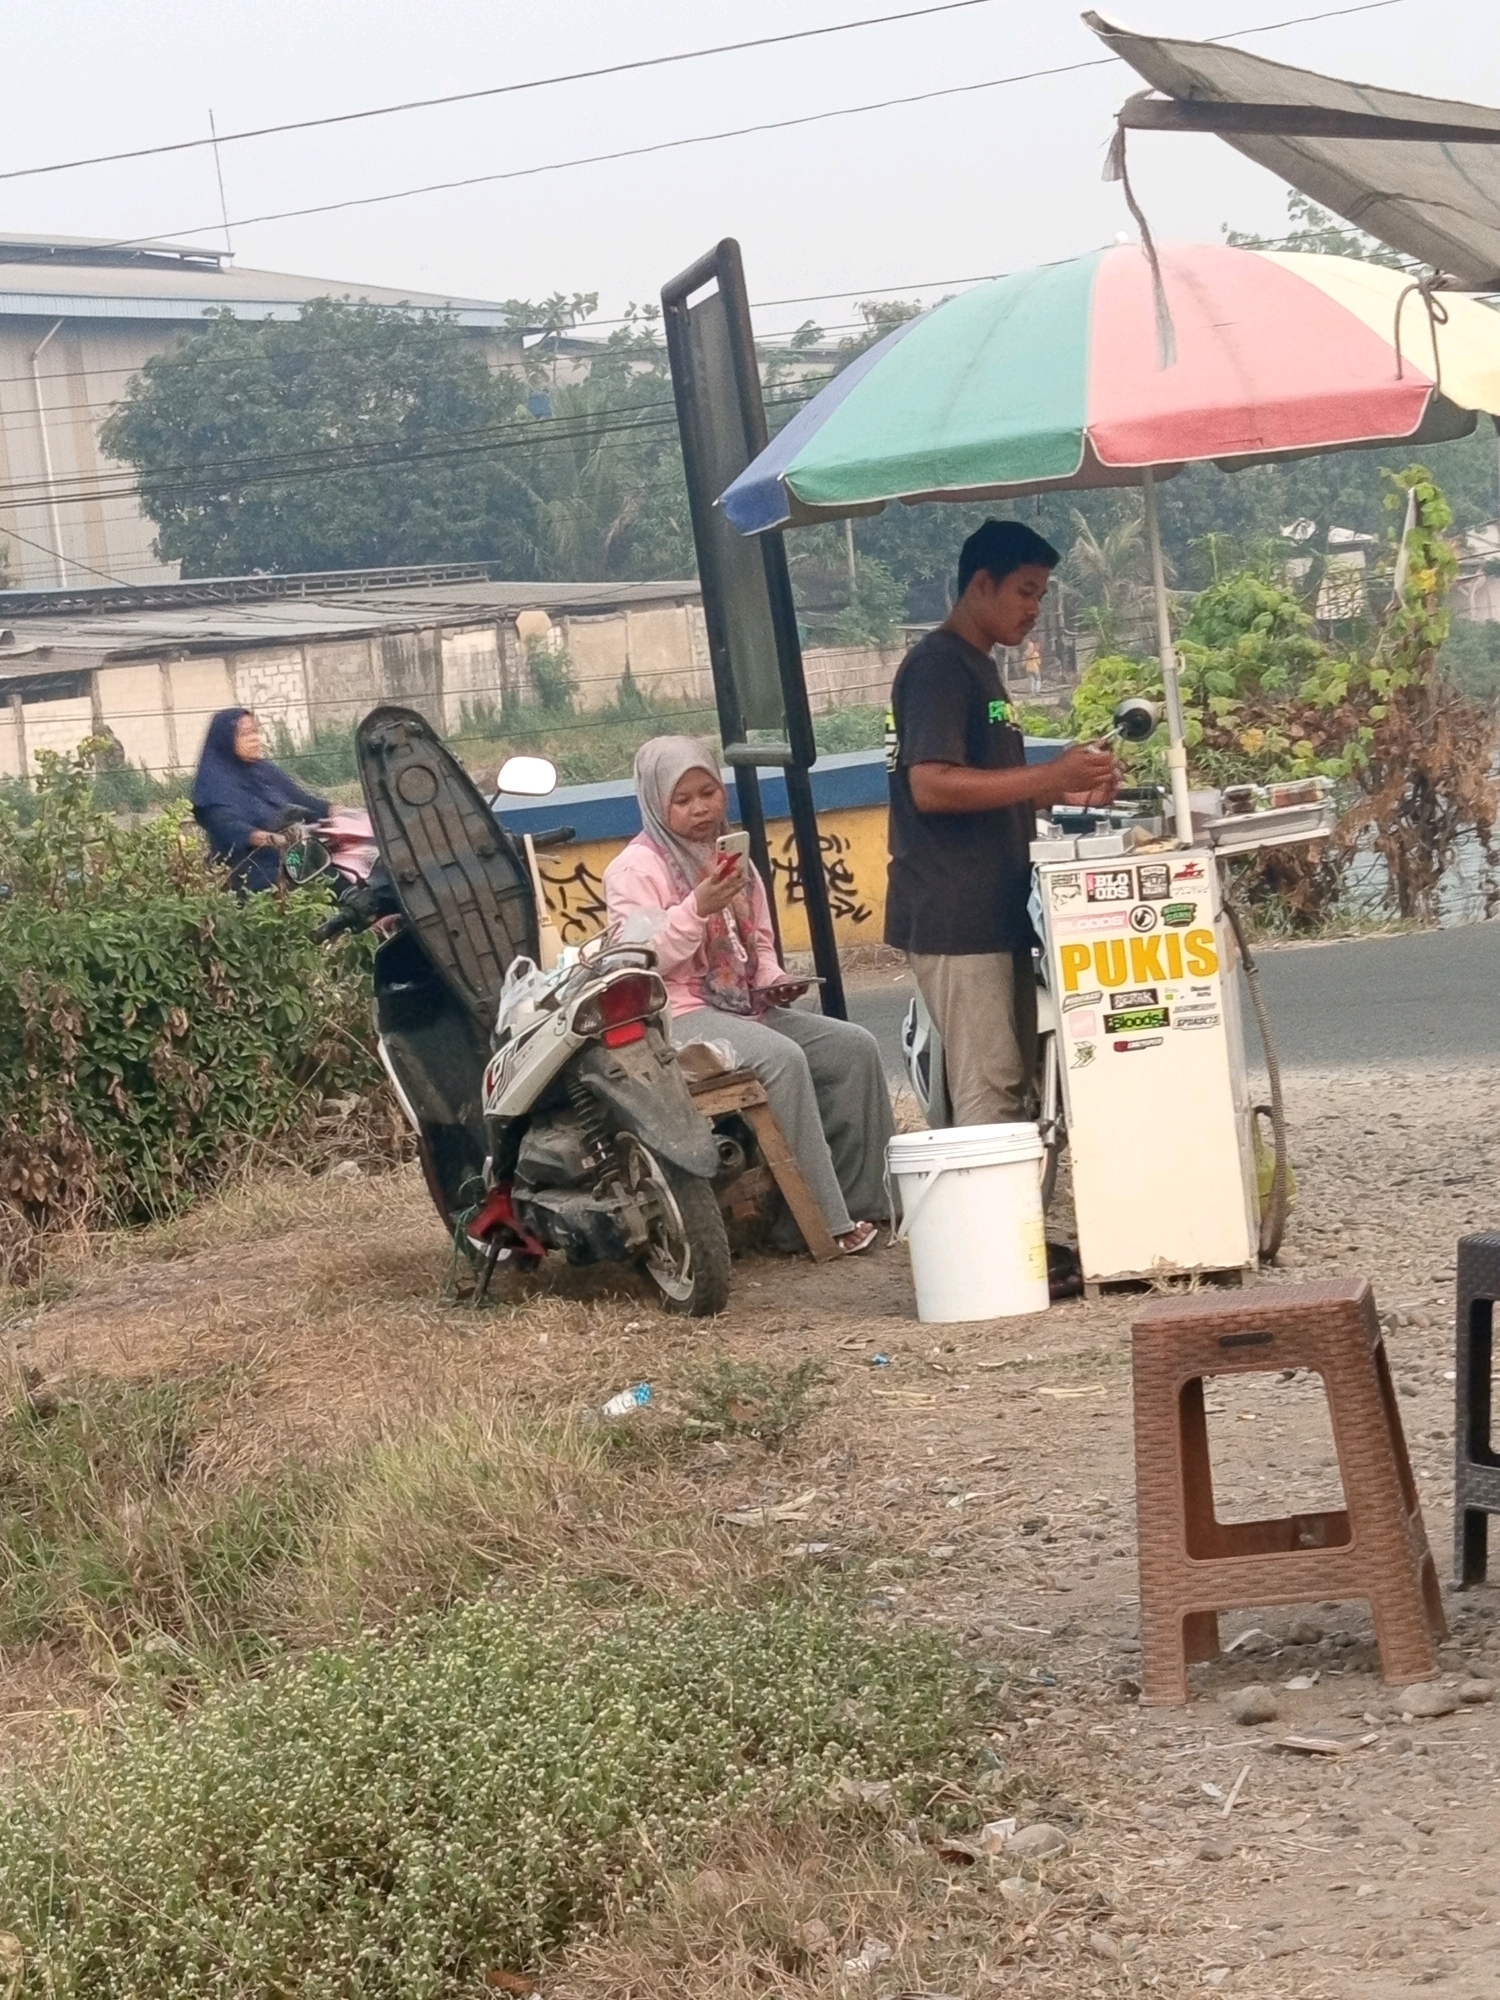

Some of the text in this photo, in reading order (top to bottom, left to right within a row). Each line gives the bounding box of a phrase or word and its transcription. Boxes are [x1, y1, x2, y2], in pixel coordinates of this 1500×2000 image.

[1094, 872, 1129, 887] BLO
[1094, 886, 1130, 900] ODS
[1057, 914, 1126, 931] BLOODS
[1060, 929, 1219, 991] PUKIS
[1112, 1012, 1160, 1029] Bloods
